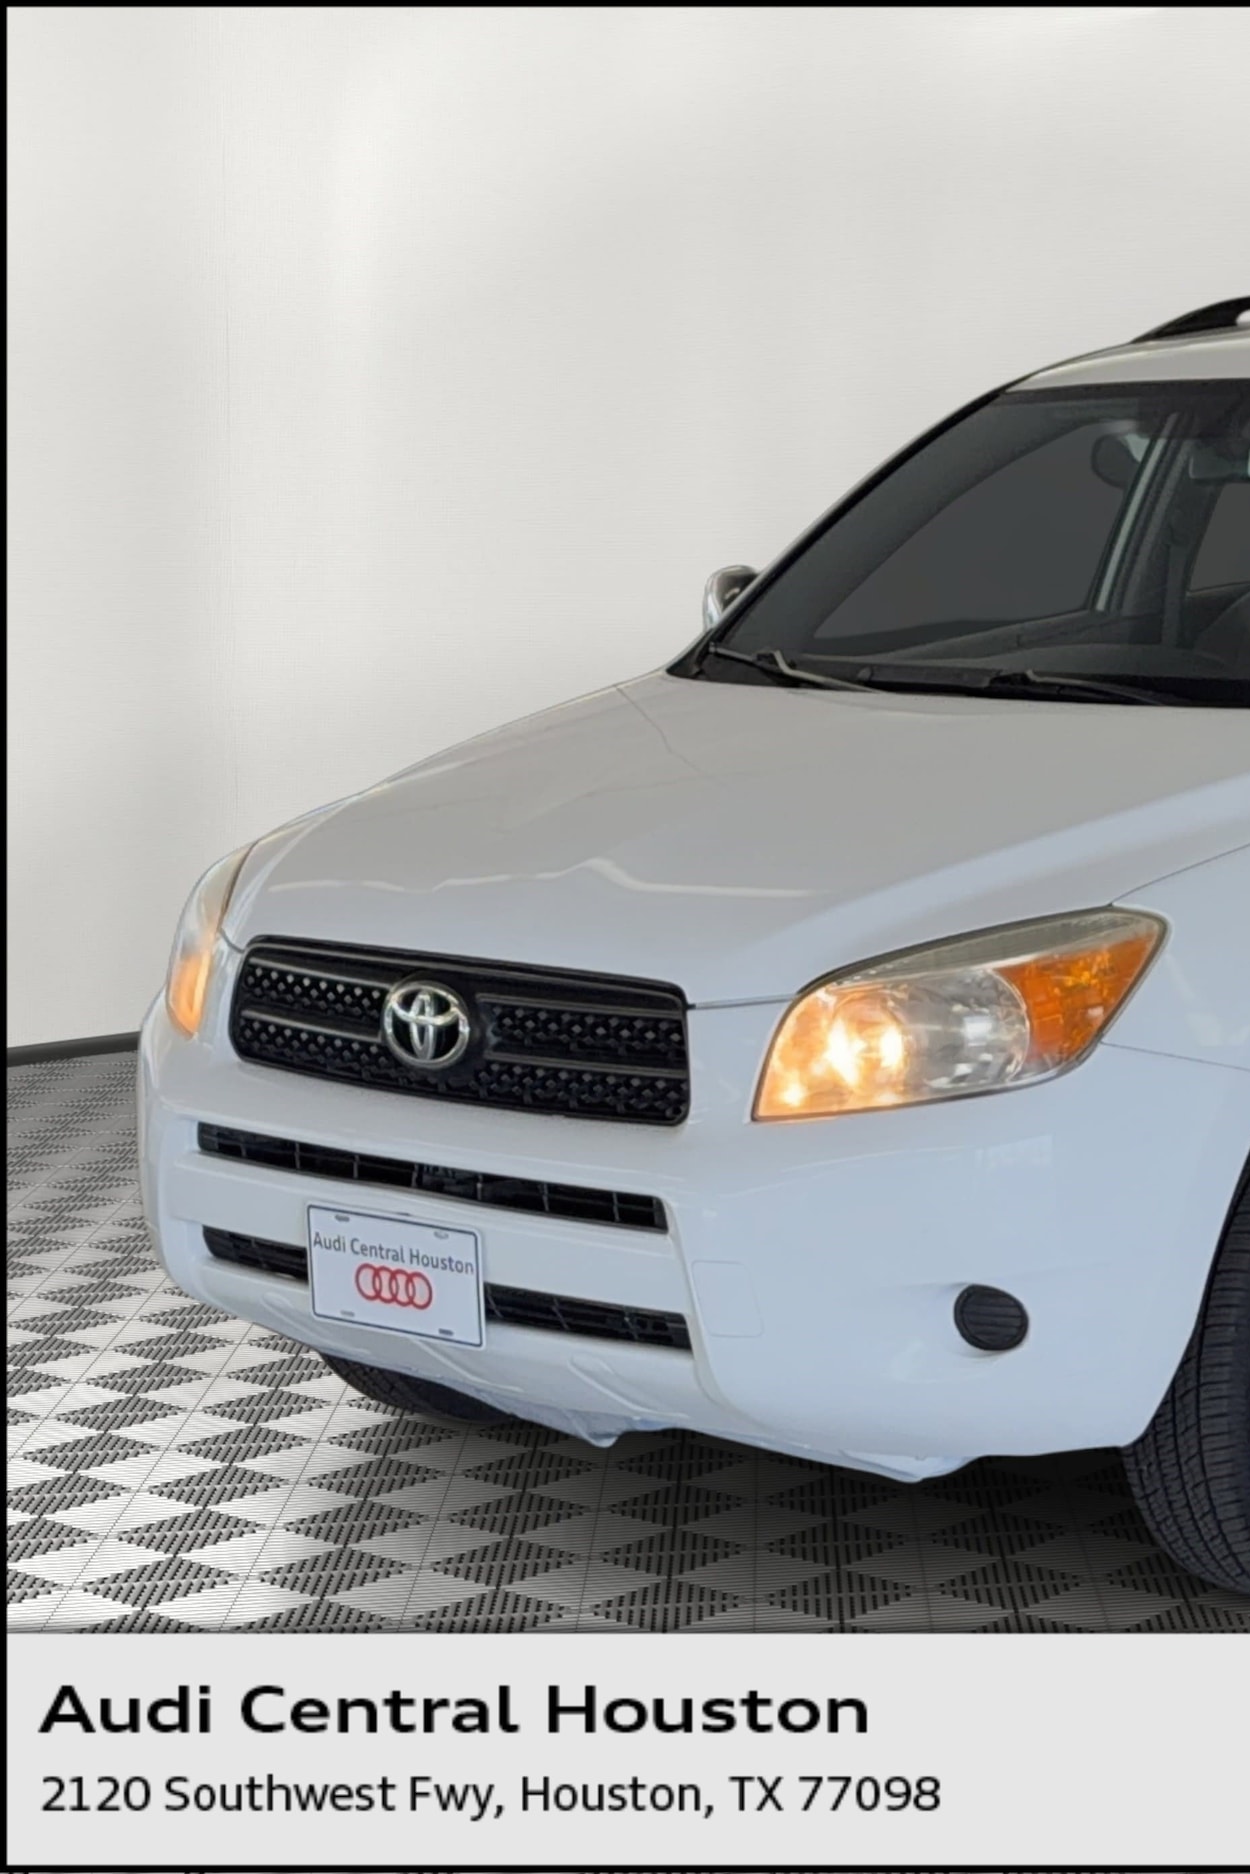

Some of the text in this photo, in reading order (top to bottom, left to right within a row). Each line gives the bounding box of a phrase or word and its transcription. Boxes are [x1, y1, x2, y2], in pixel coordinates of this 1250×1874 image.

[313, 1231, 475, 1275] Audi Central Houston
